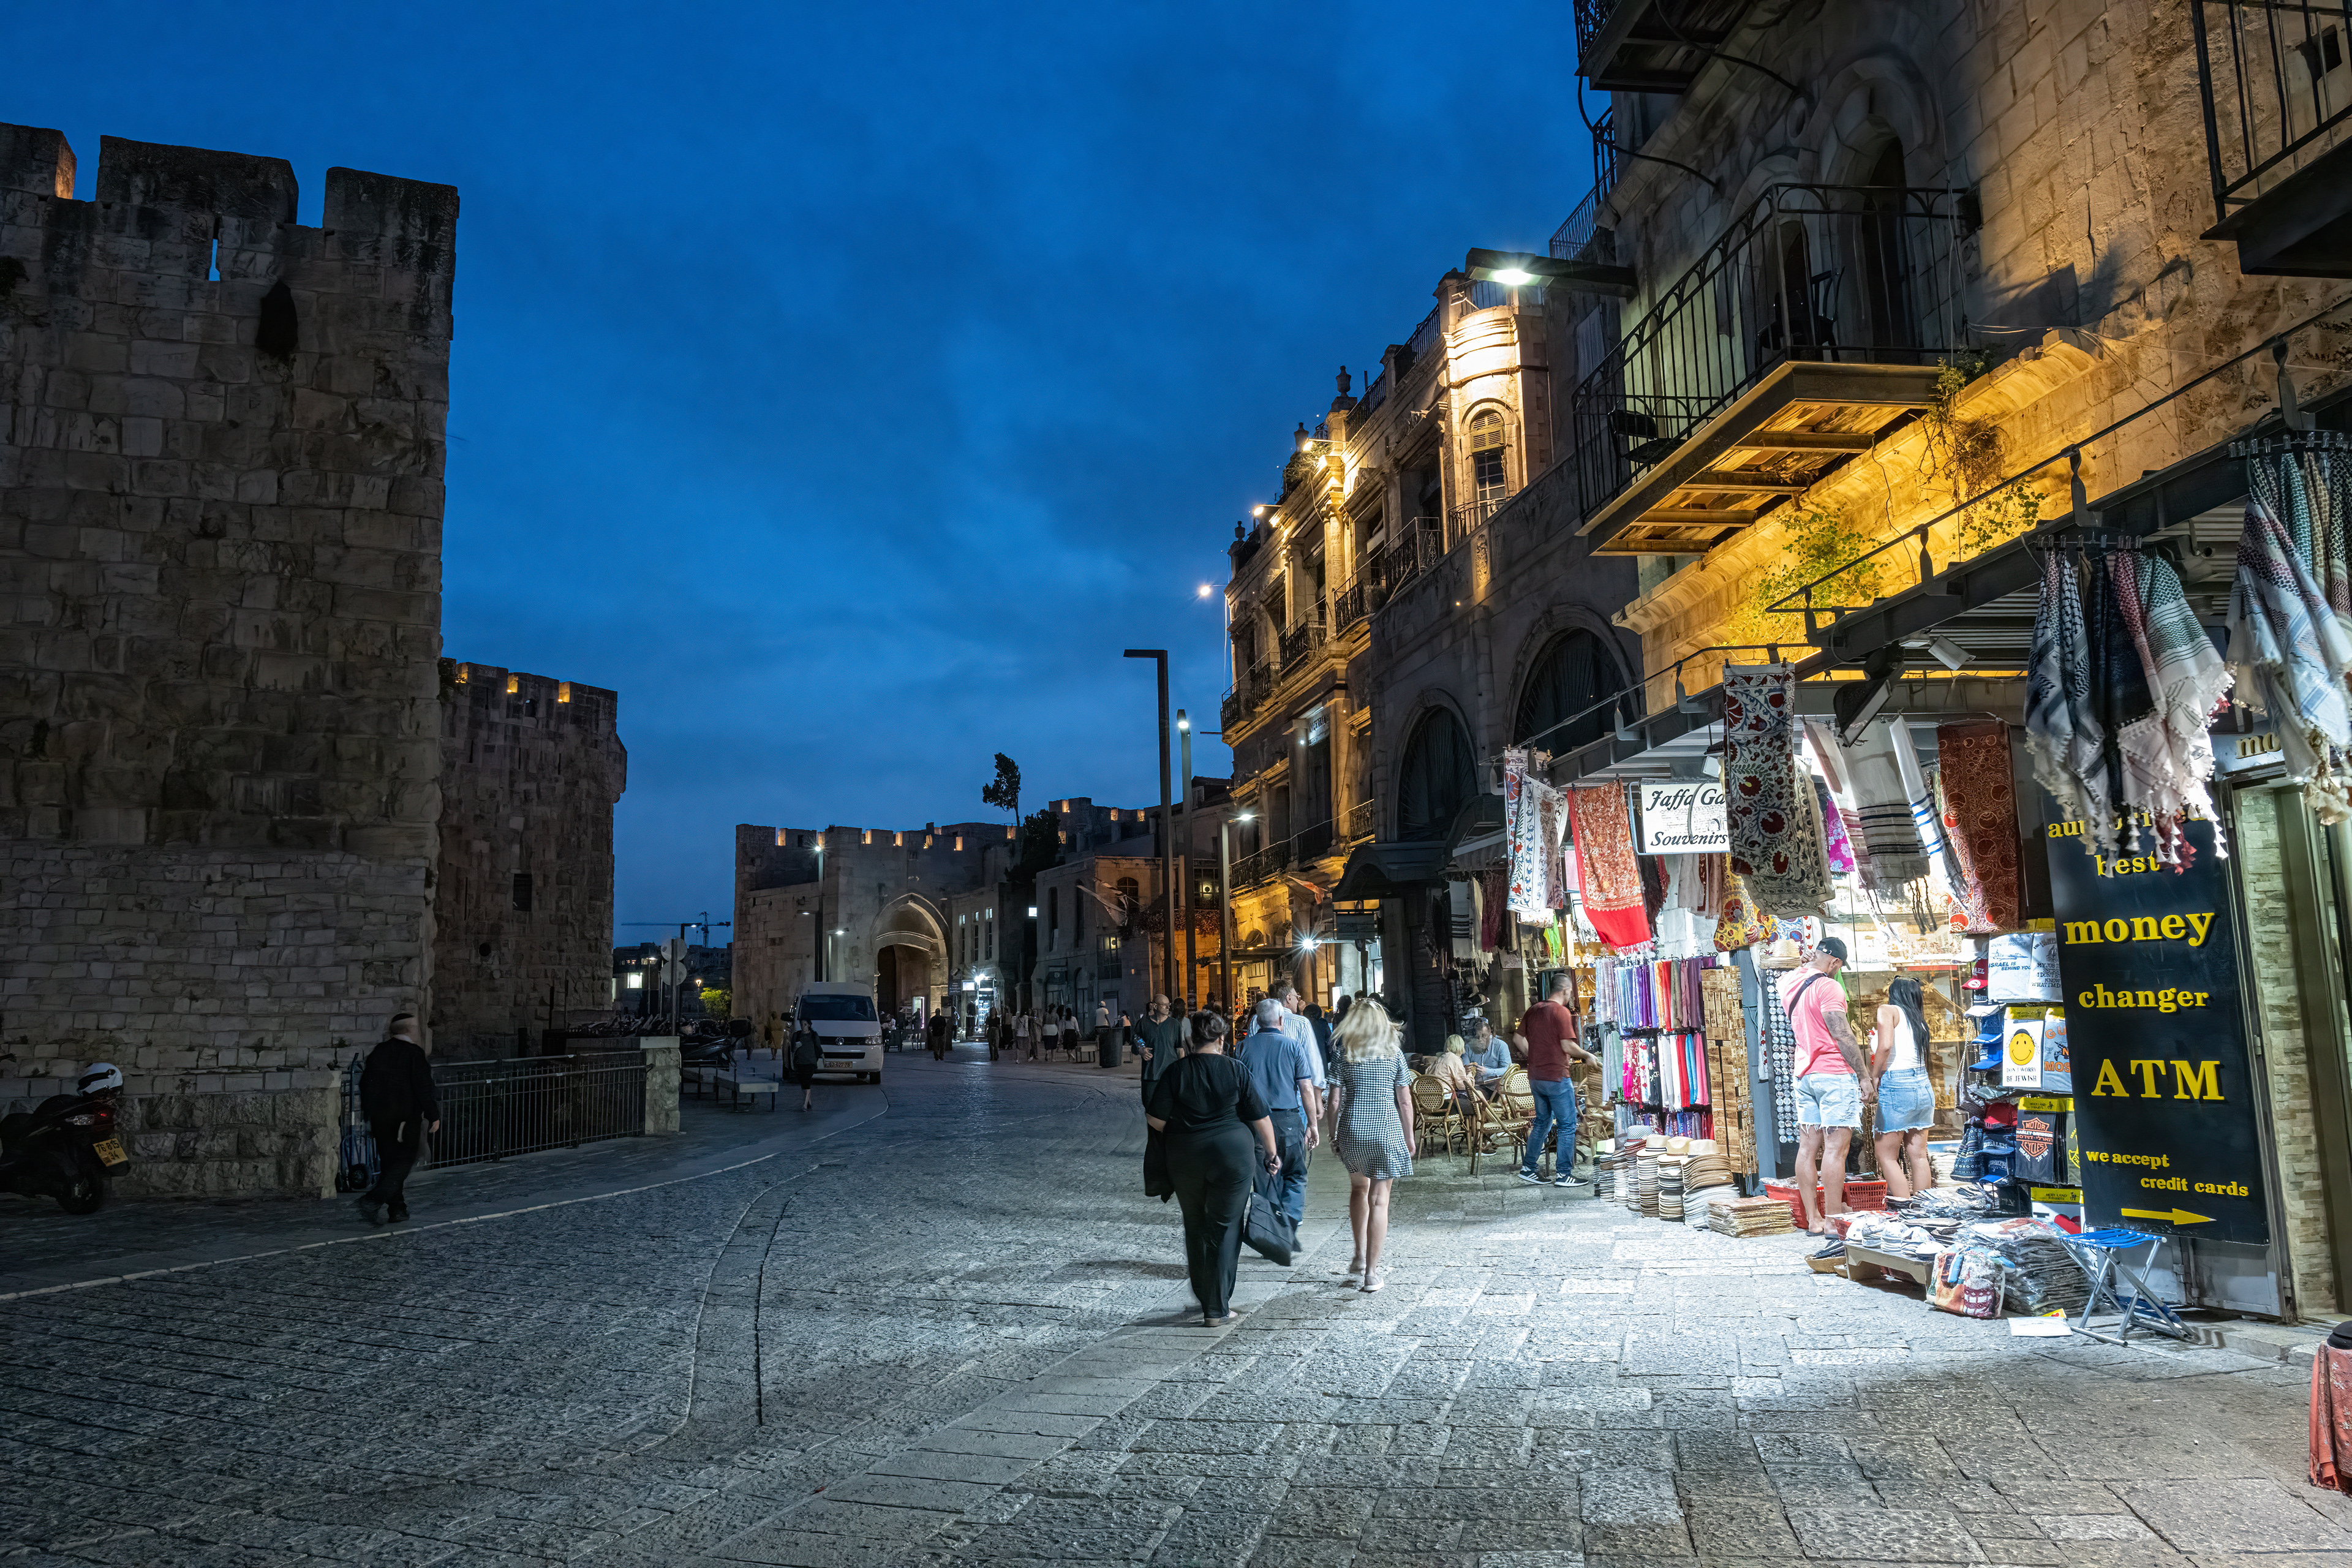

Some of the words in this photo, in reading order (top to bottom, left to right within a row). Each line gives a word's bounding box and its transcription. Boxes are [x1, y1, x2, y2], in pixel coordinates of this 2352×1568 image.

[2236, 732, 2282, 759] mo
[1646, 789, 1694, 811] Jaffa
[1701, 788, 1725, 805] Ga
[1650, 831, 1728, 846] Souvenirs
[2094, 851, 2161, 876] best
[2063, 912, 2215, 947] money
[2078, 984, 2209, 1013] changer
[2046, 1026, 2067, 1039] GU
[2044, 1061, 2071, 1072] MOS
[2091, 1058, 2225, 1100] ATM
[2026, 1120, 2046, 1131] MOTOR
[2024, 1142, 2045, 1155] CYCLES
[2086, 1151, 2109, 1163] we
[2112, 1153, 2170, 1170] accept
[2140, 1177, 2188, 1191] credit
[2194, 1181, 2249, 1197] cards
